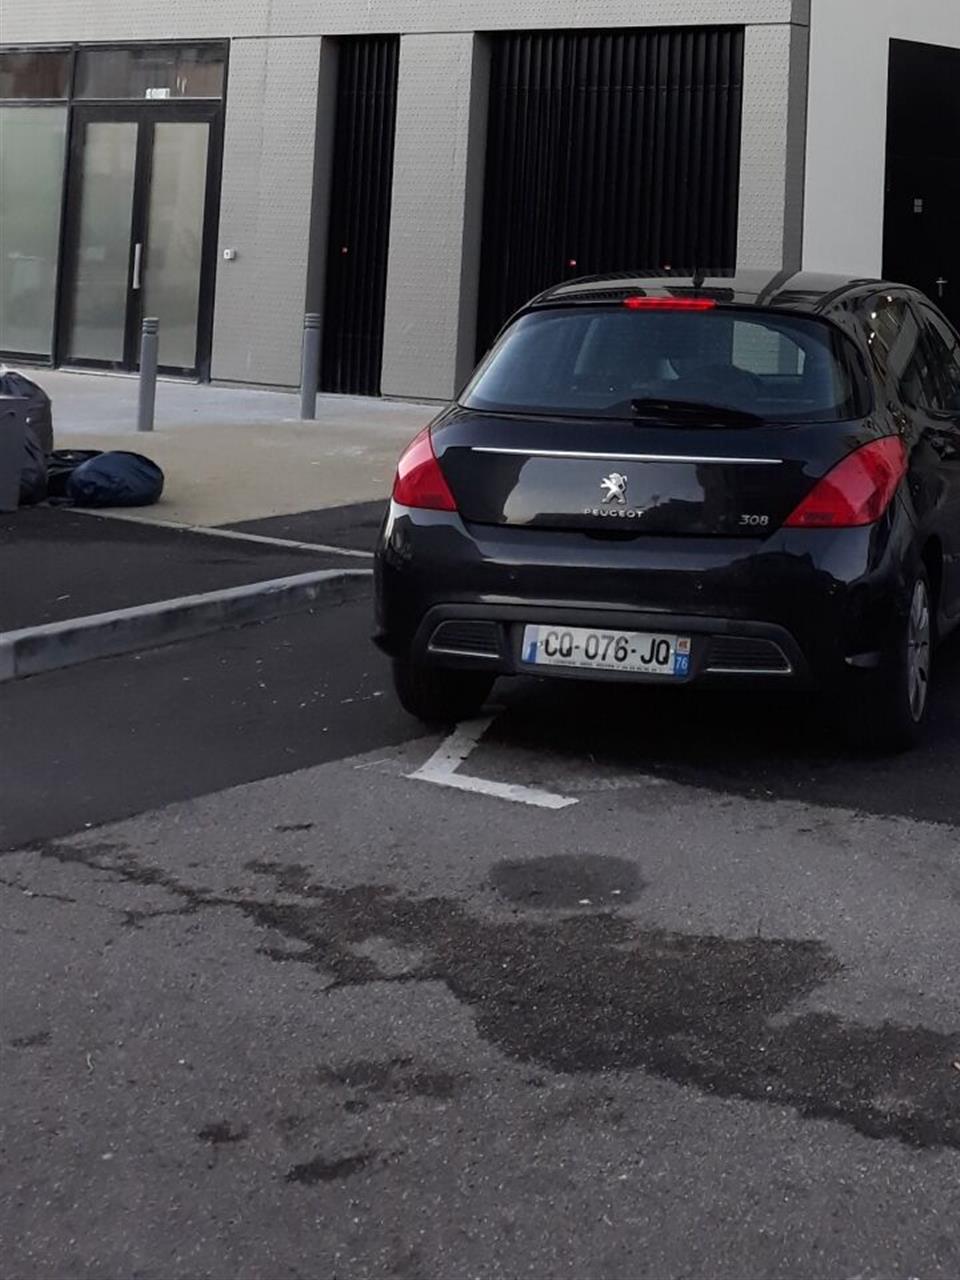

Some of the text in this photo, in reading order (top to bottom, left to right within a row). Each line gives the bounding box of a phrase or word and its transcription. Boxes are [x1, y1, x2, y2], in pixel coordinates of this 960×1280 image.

[583, 507, 645, 519] PEUGEOT
[738, 513, 769, 527] 308
[675, 656, 688, 670] 76
